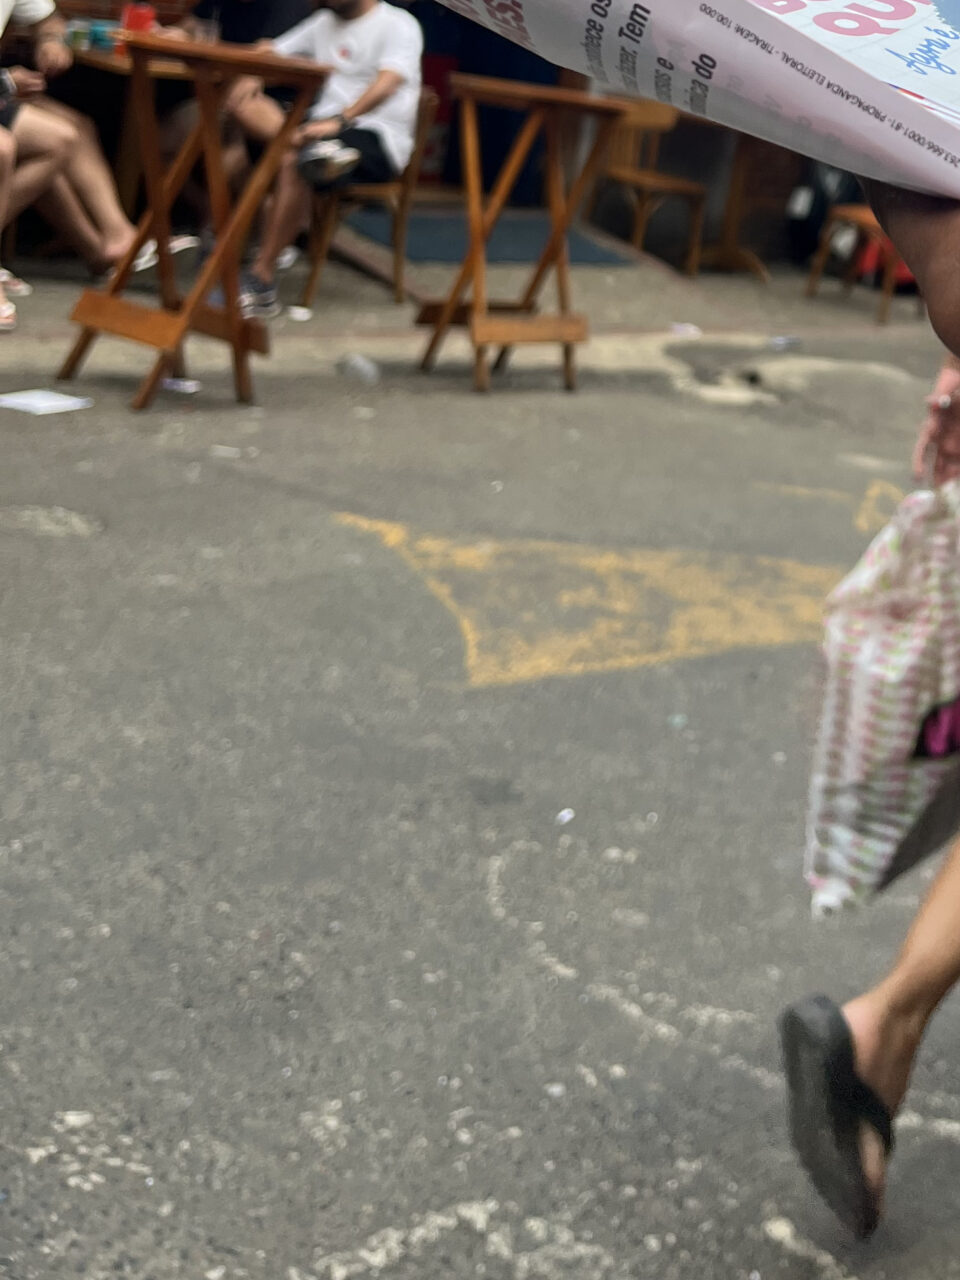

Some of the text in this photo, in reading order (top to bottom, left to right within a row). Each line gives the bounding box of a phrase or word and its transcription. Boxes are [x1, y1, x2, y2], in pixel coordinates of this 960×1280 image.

[618, 3, 652, 44] Tem
[699, 2, 734, 29] 100.000
[734, 23, 776, 54] TIRAGEM:
[657, 56, 675, 71] e
[692, 53, 717, 81] do
[781, 52, 825, 87] ELEITORAL
[824, 80, 888, 122] PROPAGANDA
